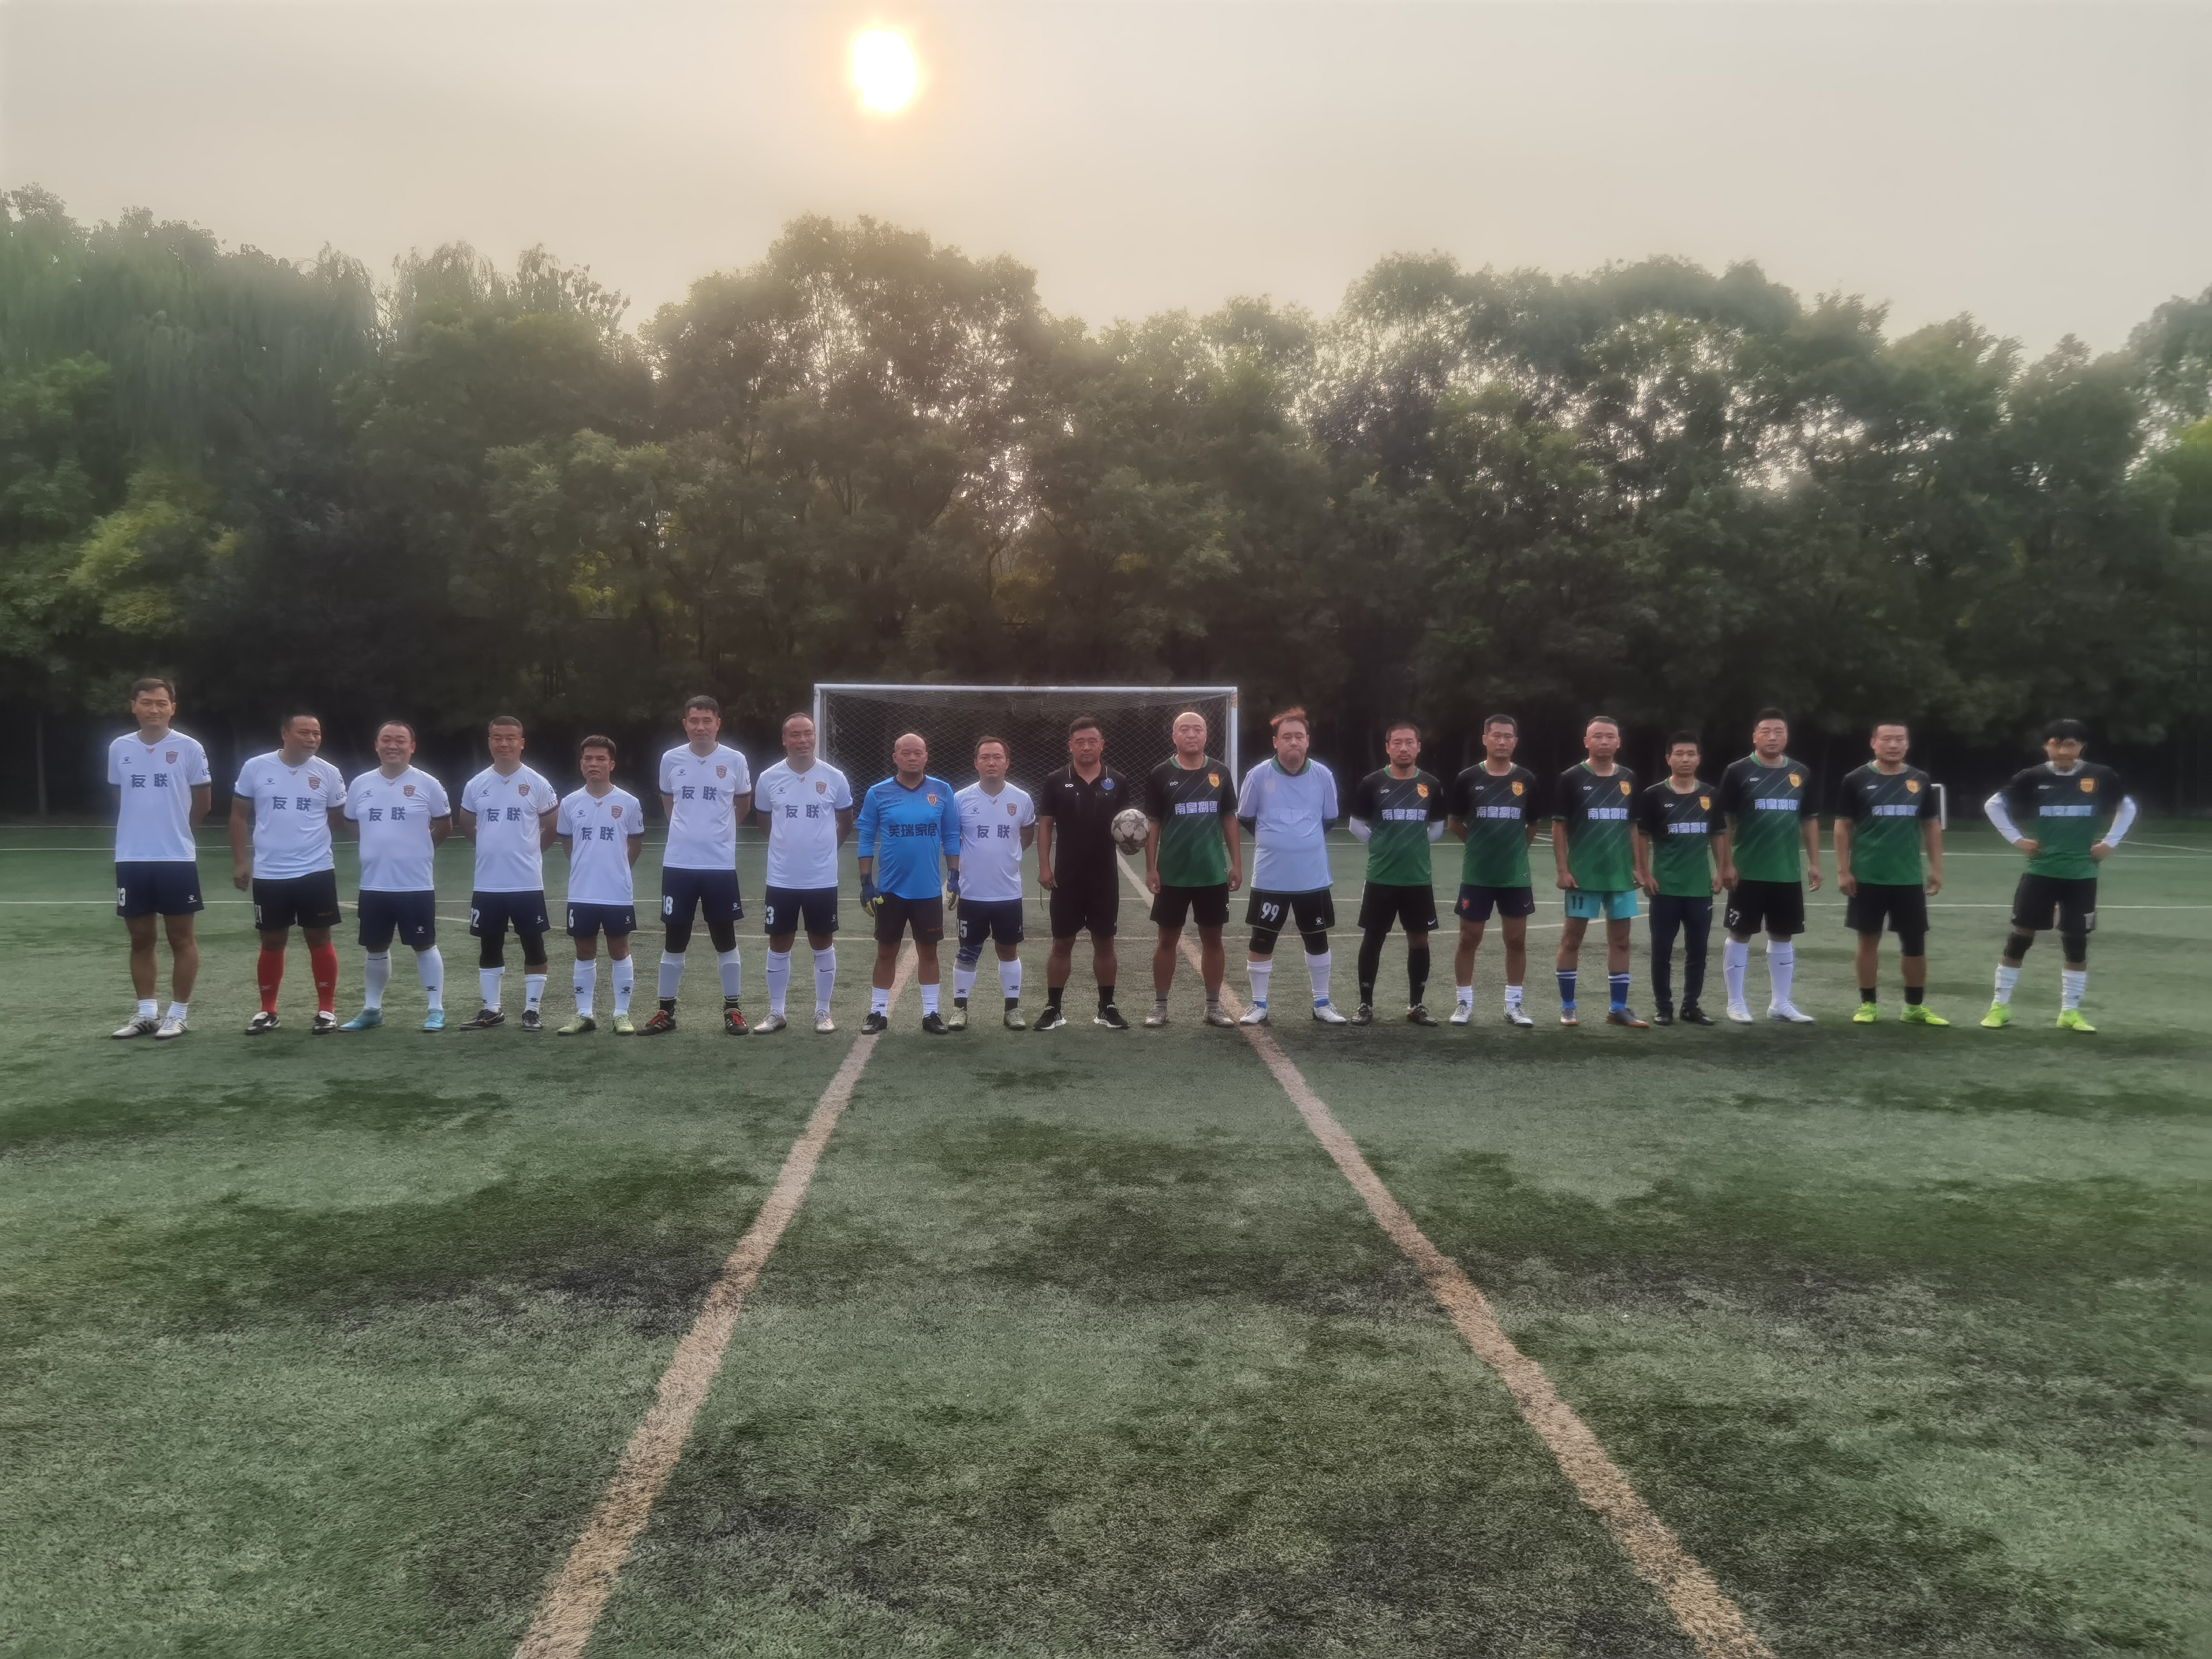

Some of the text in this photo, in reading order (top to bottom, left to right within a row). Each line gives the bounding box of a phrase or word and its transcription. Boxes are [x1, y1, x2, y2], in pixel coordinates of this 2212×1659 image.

[131, 773, 168, 788] 友联
[682, 785, 717, 800] 友联
[272, 796, 312, 812] 友联
[368, 807, 406, 822] 友联
[487, 807, 521, 822] 友联
[785, 805, 819, 819] 友联
[581, 826, 615, 841] 友联
[888, 823, 937, 838] 芙瑞家居
[976, 825, 1010, 839] 友联
[1571, 895, 1583, 910] 11
[1260, 902, 1280, 922] 99
